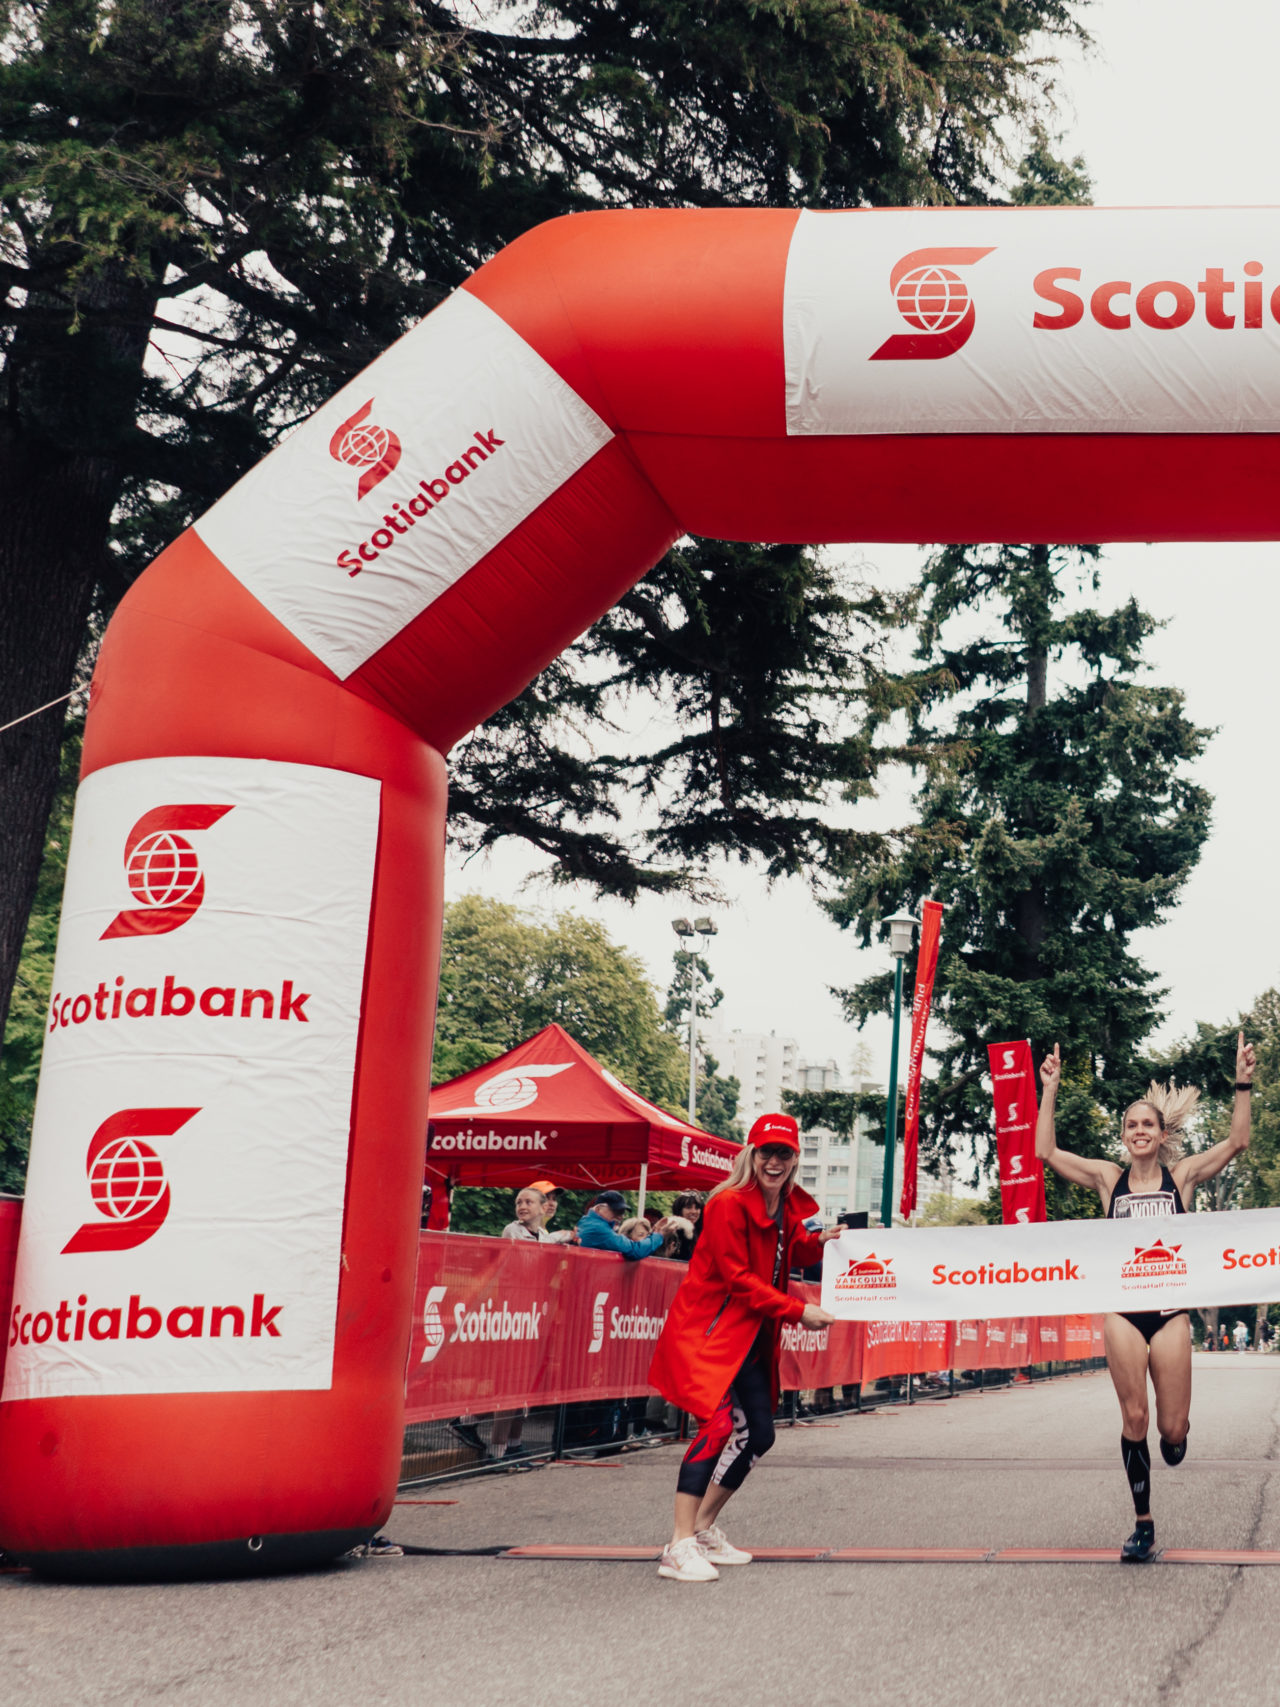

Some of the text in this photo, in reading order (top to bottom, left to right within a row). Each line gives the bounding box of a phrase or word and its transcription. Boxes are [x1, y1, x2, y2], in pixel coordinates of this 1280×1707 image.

[337, 428, 506, 578] Scotiabank
[49, 975, 312, 1033] Scotiabank
[431, 1130, 547, 1151] cotiabank
[691, 1145, 735, 1173] Scotiabank
[1130, 1201, 1173, 1217] WODAK
[835, 1275, 897, 1285] VANCOUVER
[932, 1258, 1080, 1286] Scotiabank
[1121, 1263, 1187, 1273] VANCOUVER
[9, 1294, 285, 1348] Scotiabank
[449, 1300, 539, 1343] Scotiabank
[609, 1303, 669, 1341] Scotiaban
